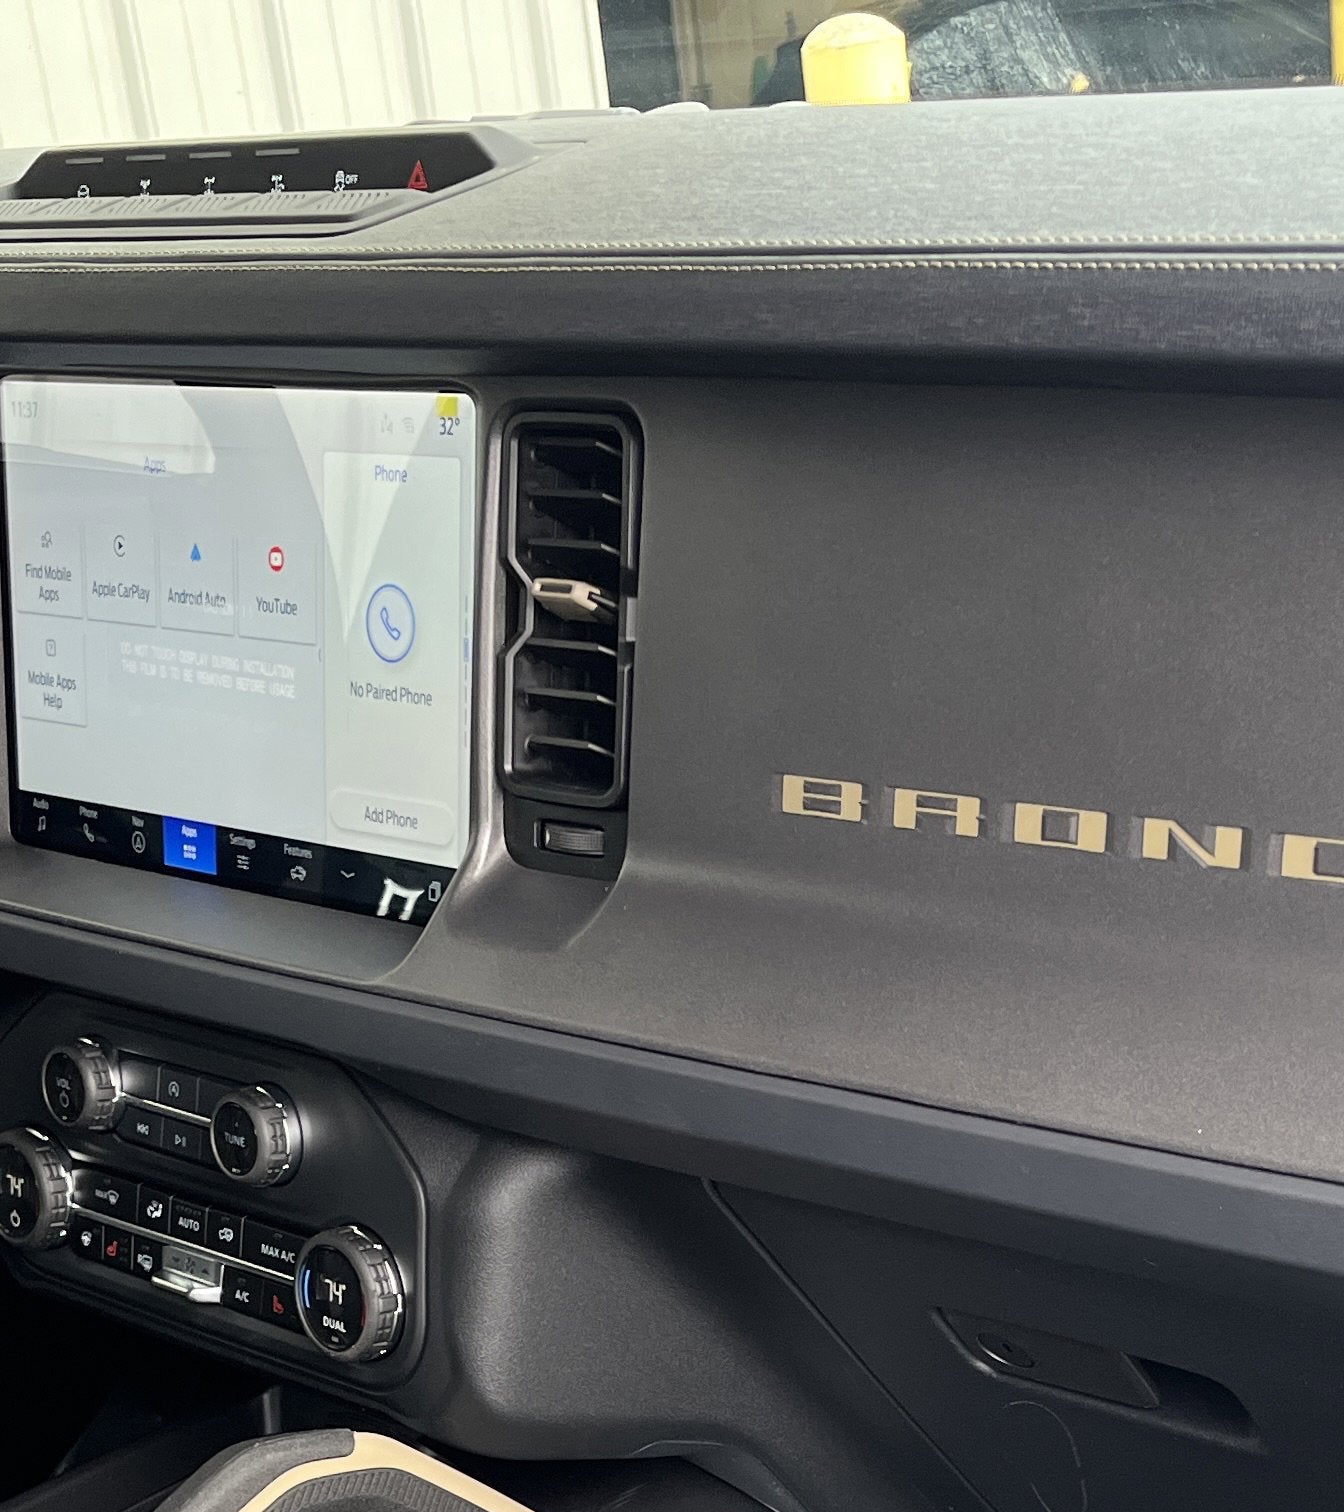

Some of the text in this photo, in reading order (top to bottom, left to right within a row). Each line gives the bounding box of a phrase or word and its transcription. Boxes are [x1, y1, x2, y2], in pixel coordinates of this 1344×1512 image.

[12, 401, 38, 419] 11:37
[144, 456, 166, 474] Apps
[374, 465, 408, 483] Phone
[25, 563, 72, 582] Find Mobile
[39, 586, 60, 602] Apps
[92, 581, 150, 603] Apple CarPlay
[168, 589, 226, 608] Android Auto
[256, 596, 298, 615] YouTube
[28, 670, 77, 691] Mobile Apps
[43, 693, 63, 709] Help
[350, 681, 433, 706] No Paired Phone
[364, 806, 418, 830] Add Phone
[181, 825, 198, 838] Apps
[229, 833, 256, 850] Settings
[283, 843, 313, 860] Features
[56, 1077, 71, 1091] VOL
[224, 1131, 246, 1149] TUNE
[178, 1216, 200, 1232] AUTO
[260, 1243, 296, 1265] MAX A/C
[234, 1289, 250, 1303] A/C
[322, 1315, 347, 1334] DUAL
